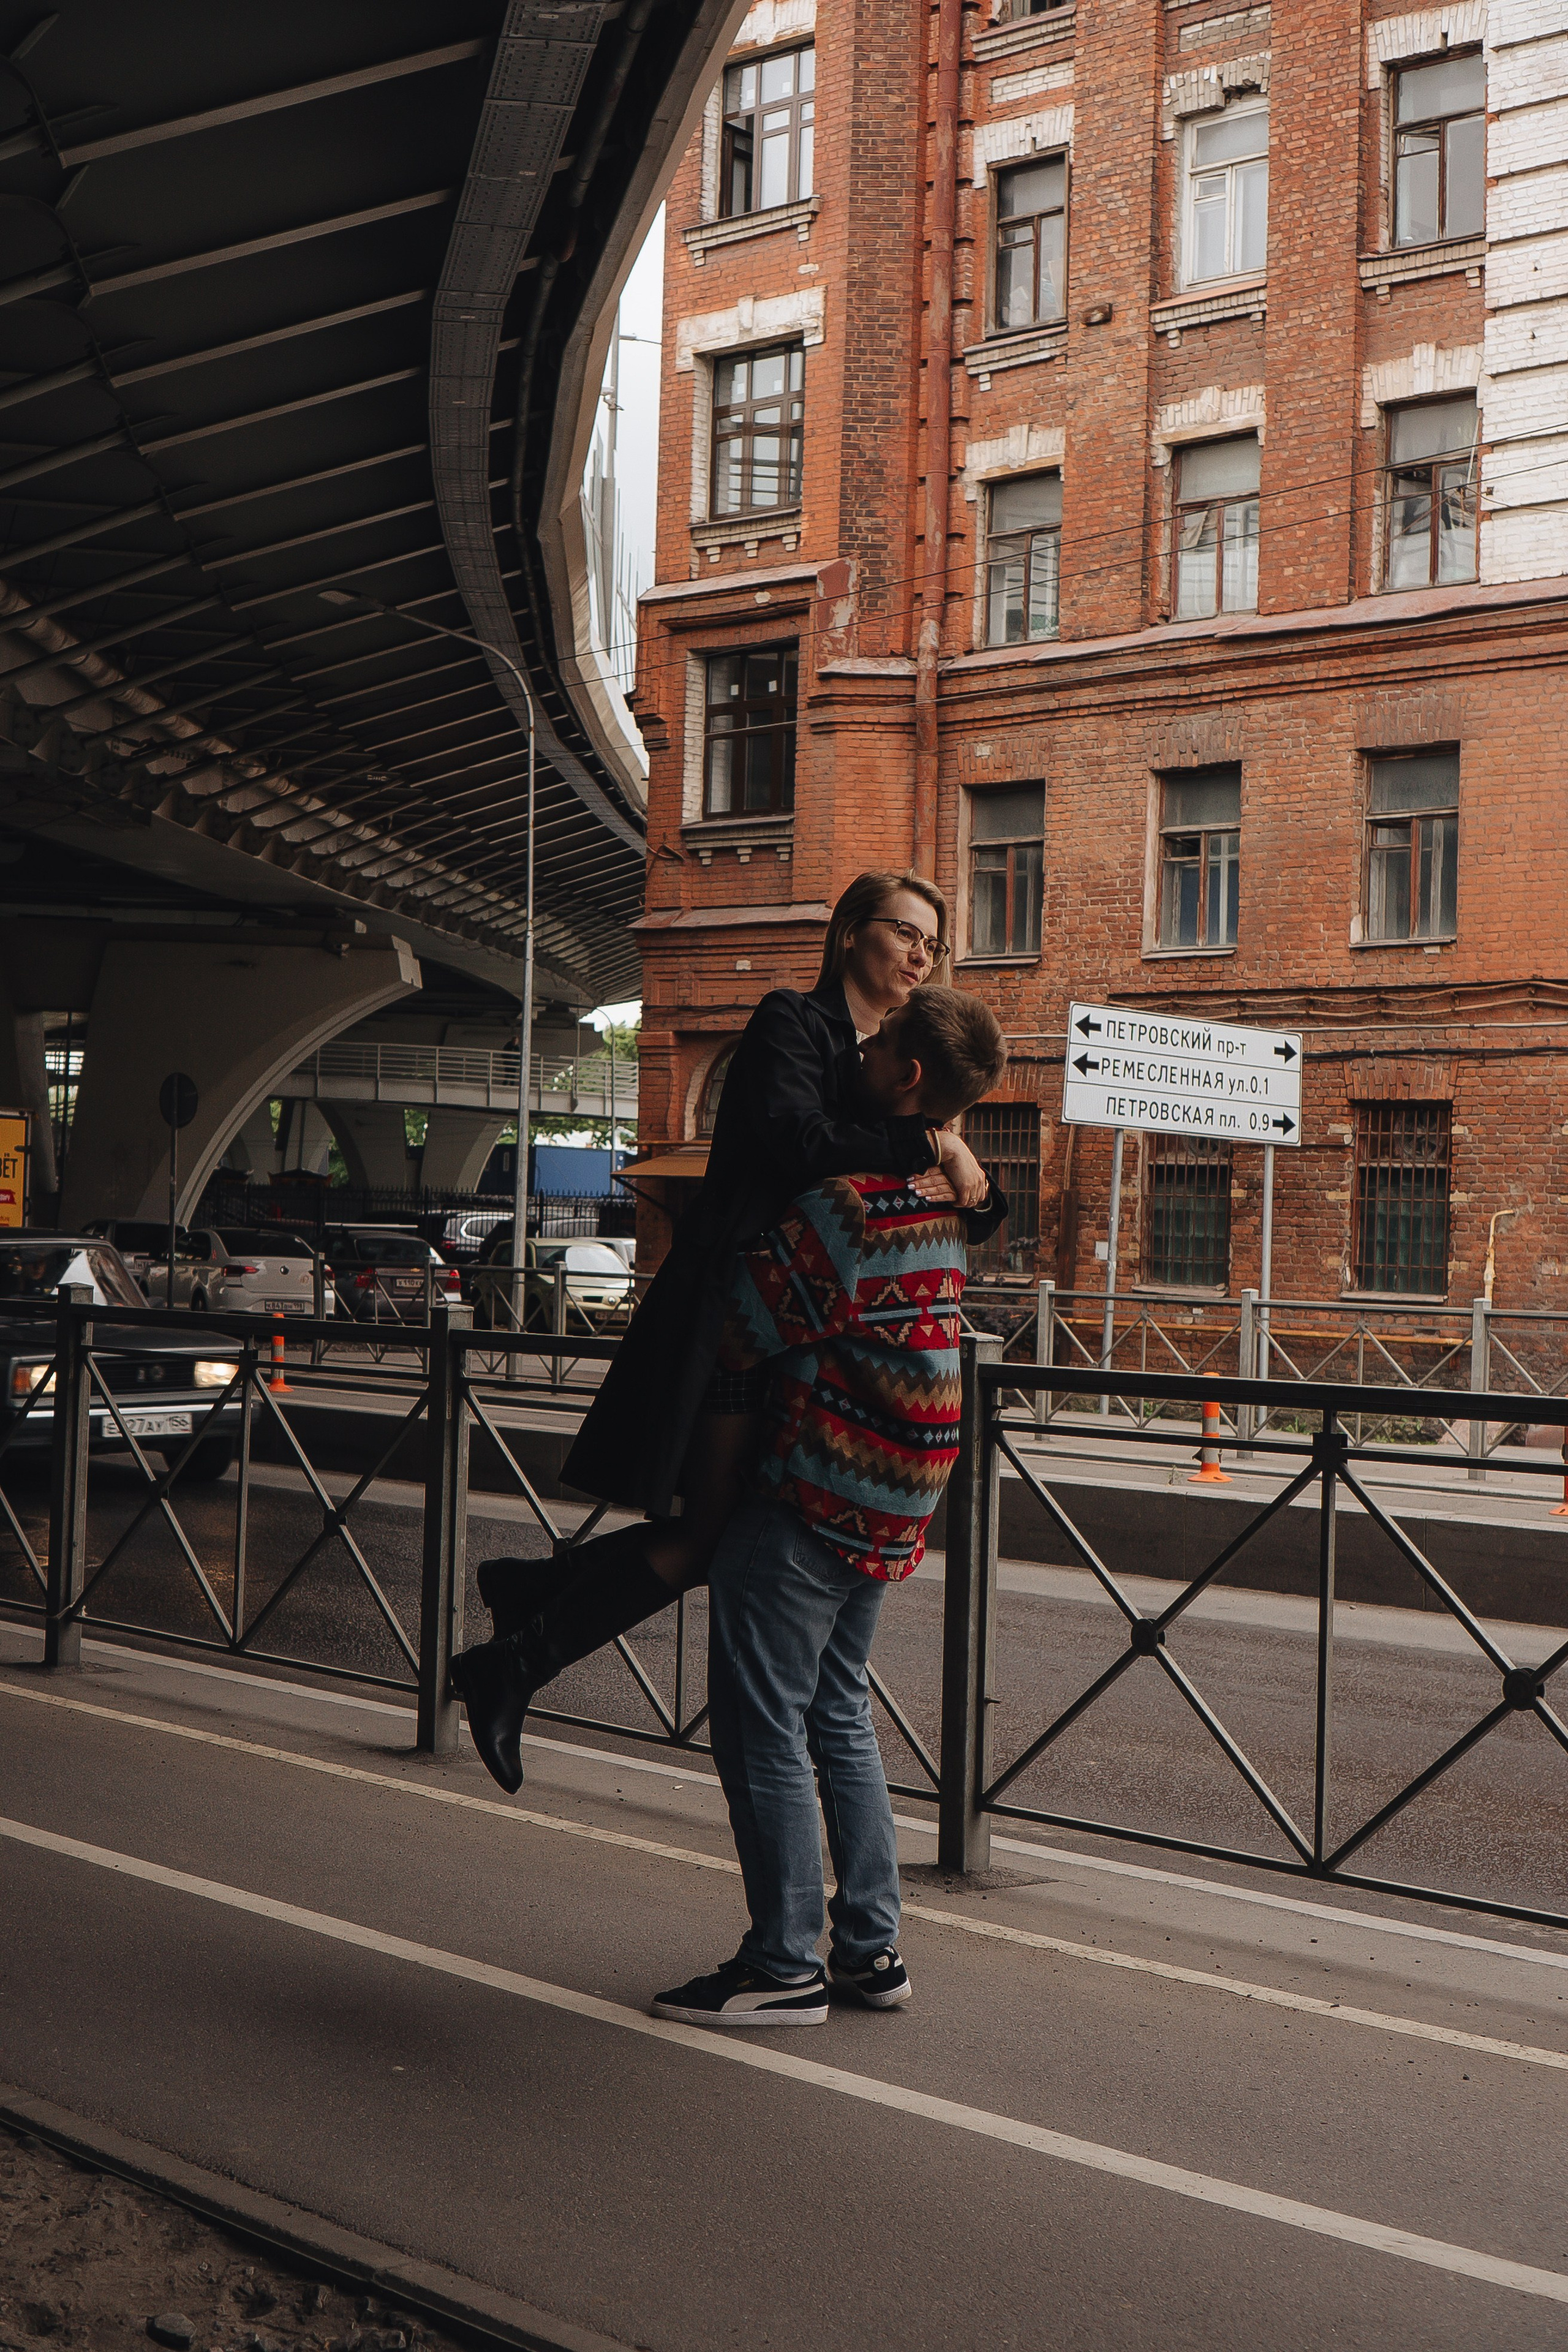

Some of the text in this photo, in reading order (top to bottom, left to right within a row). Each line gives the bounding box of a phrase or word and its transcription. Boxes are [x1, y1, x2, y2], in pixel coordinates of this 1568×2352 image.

[1106, 1020, 1247, 1058] ПЕТРОВСКИЙ пр-т
[1101, 1058, 1224, 1090] РЕМЕСЛЕННАЯ
[1106, 1096, 1269, 1132] ПЕТРОВСКАЯ пл. 0,9
